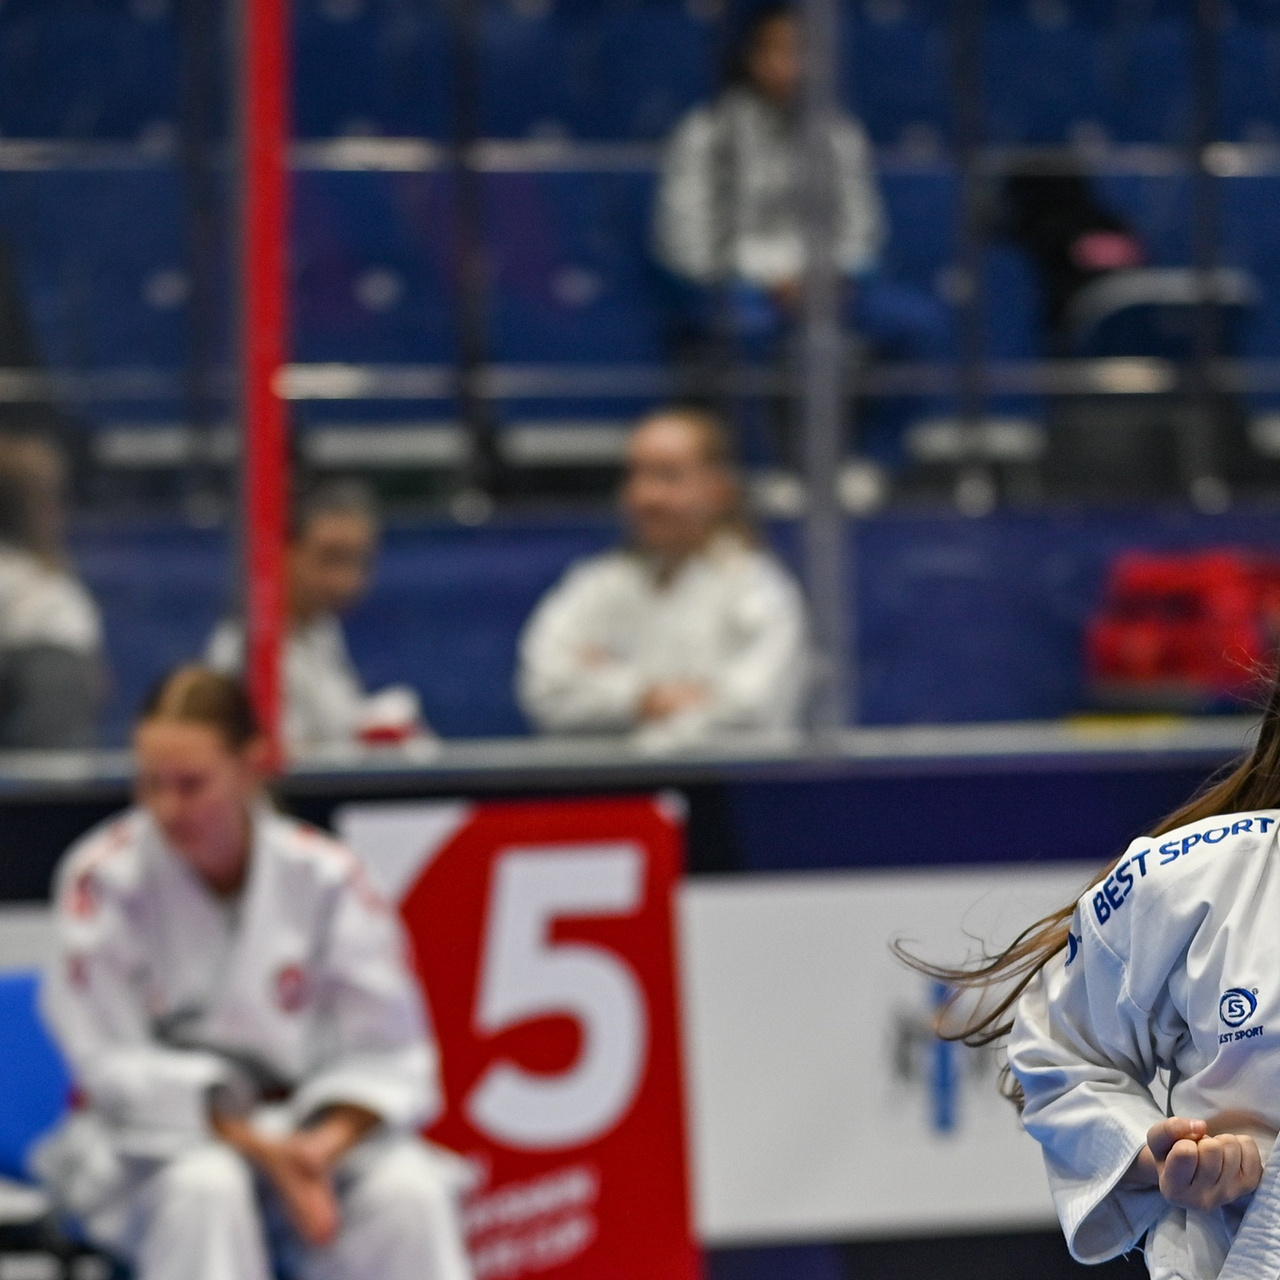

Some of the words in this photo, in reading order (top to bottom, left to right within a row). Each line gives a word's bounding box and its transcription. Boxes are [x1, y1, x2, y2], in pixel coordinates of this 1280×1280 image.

[1092, 848, 1151, 926] BEST
[1158, 817, 1275, 866] SPORT
[464, 840, 650, 1149] 5
[1218, 1032, 1233, 1045] EST
[1234, 1025, 1264, 1041] SPORT
